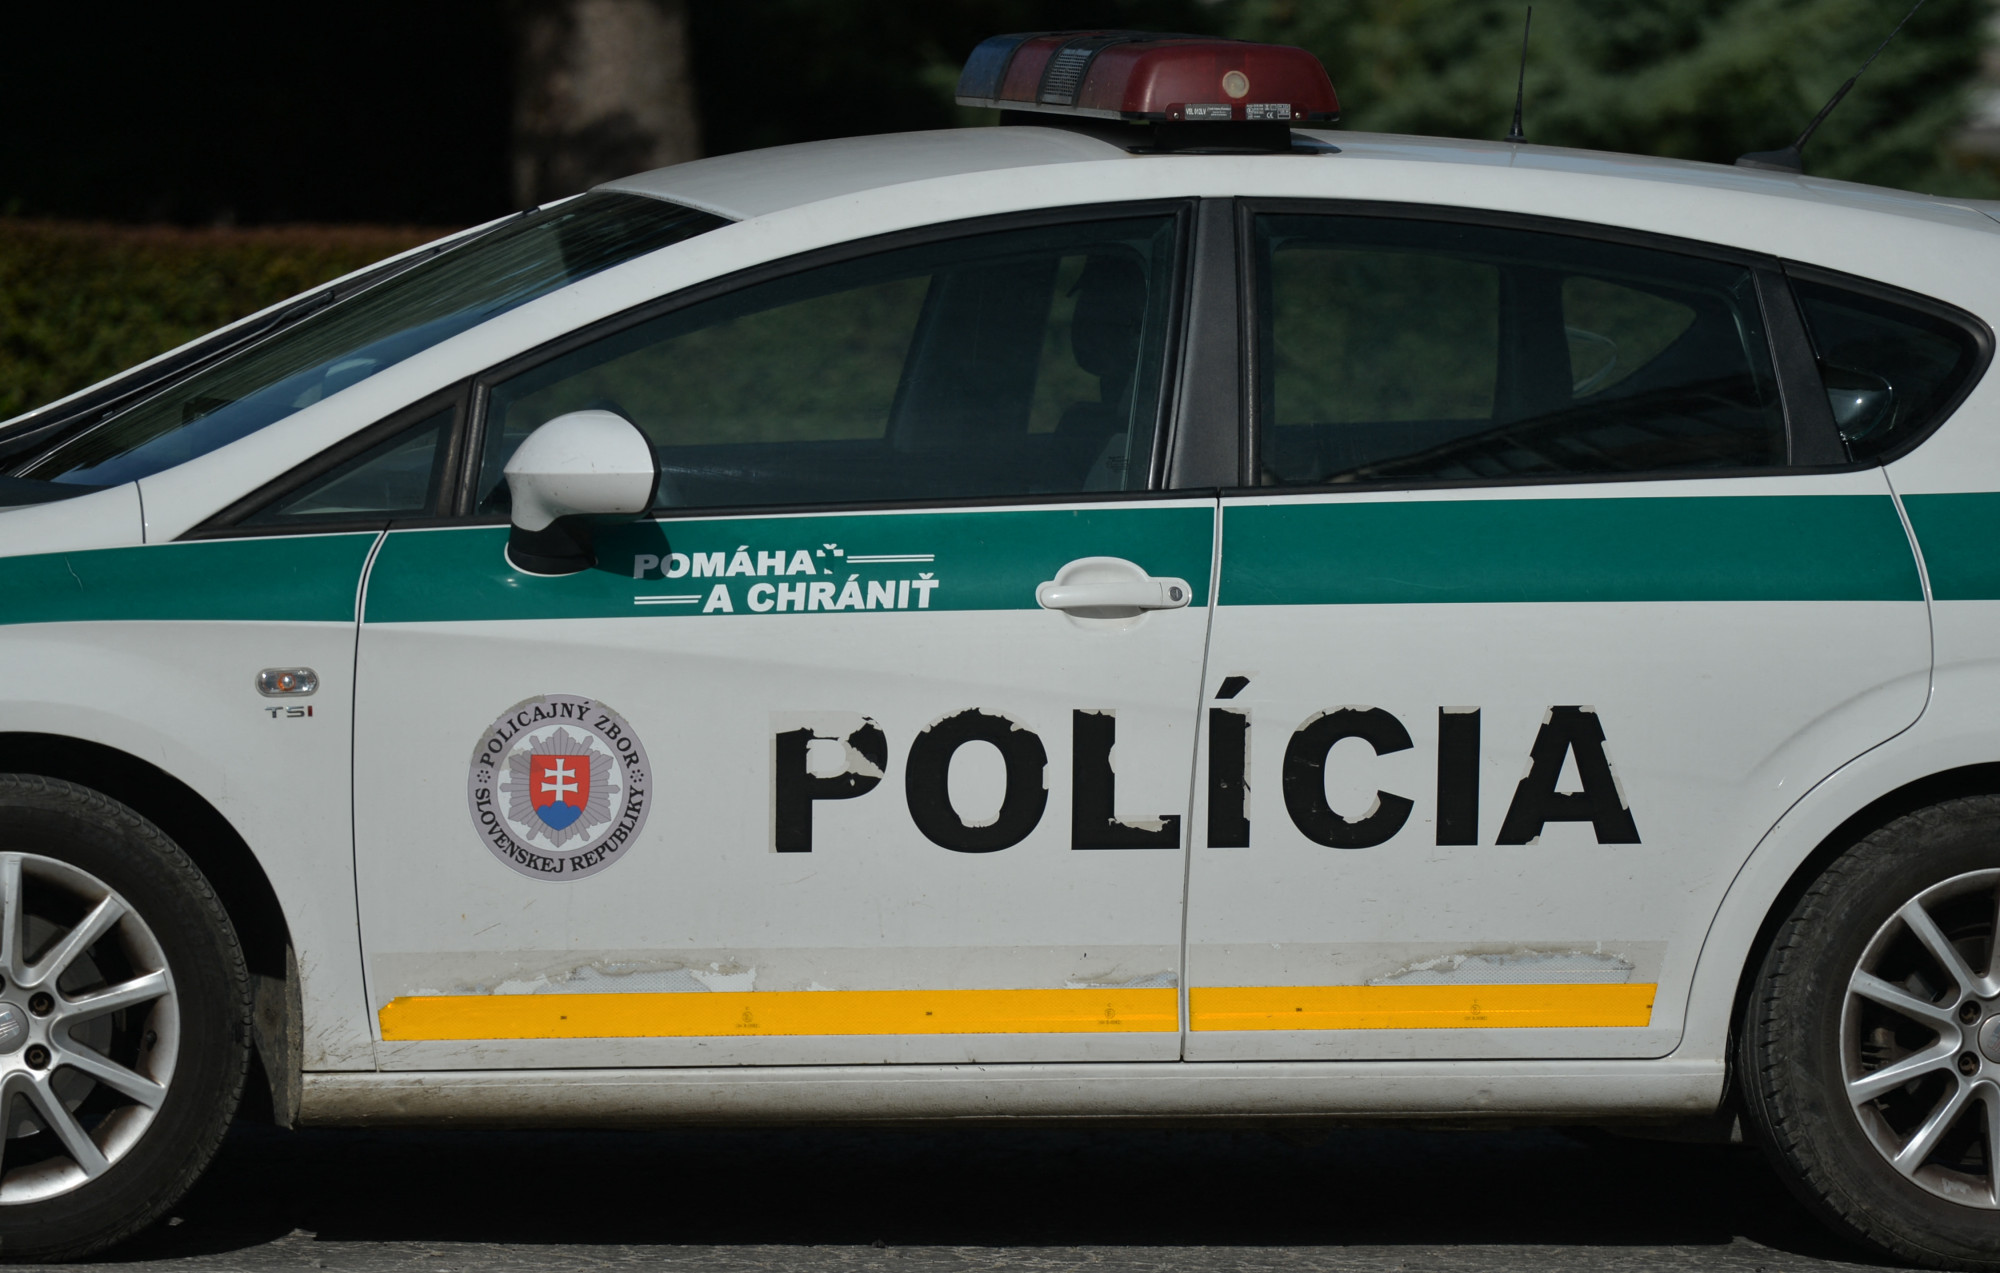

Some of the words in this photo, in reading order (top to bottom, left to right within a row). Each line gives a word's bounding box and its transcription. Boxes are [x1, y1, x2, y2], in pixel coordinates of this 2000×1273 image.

[702, 583, 734, 613] A
[747, 572, 939, 612] CHRÁNIŤ
[264, 705, 313, 718] TSI
[480, 701, 591, 768] POLICAJNÝ
[594, 714, 640, 769] ZBOR
[771, 676, 1643, 854] POLÍCIA
[475, 787, 565, 873] SLOVENSKEJ
[570, 785, 645, 872] REPUBLIKY
